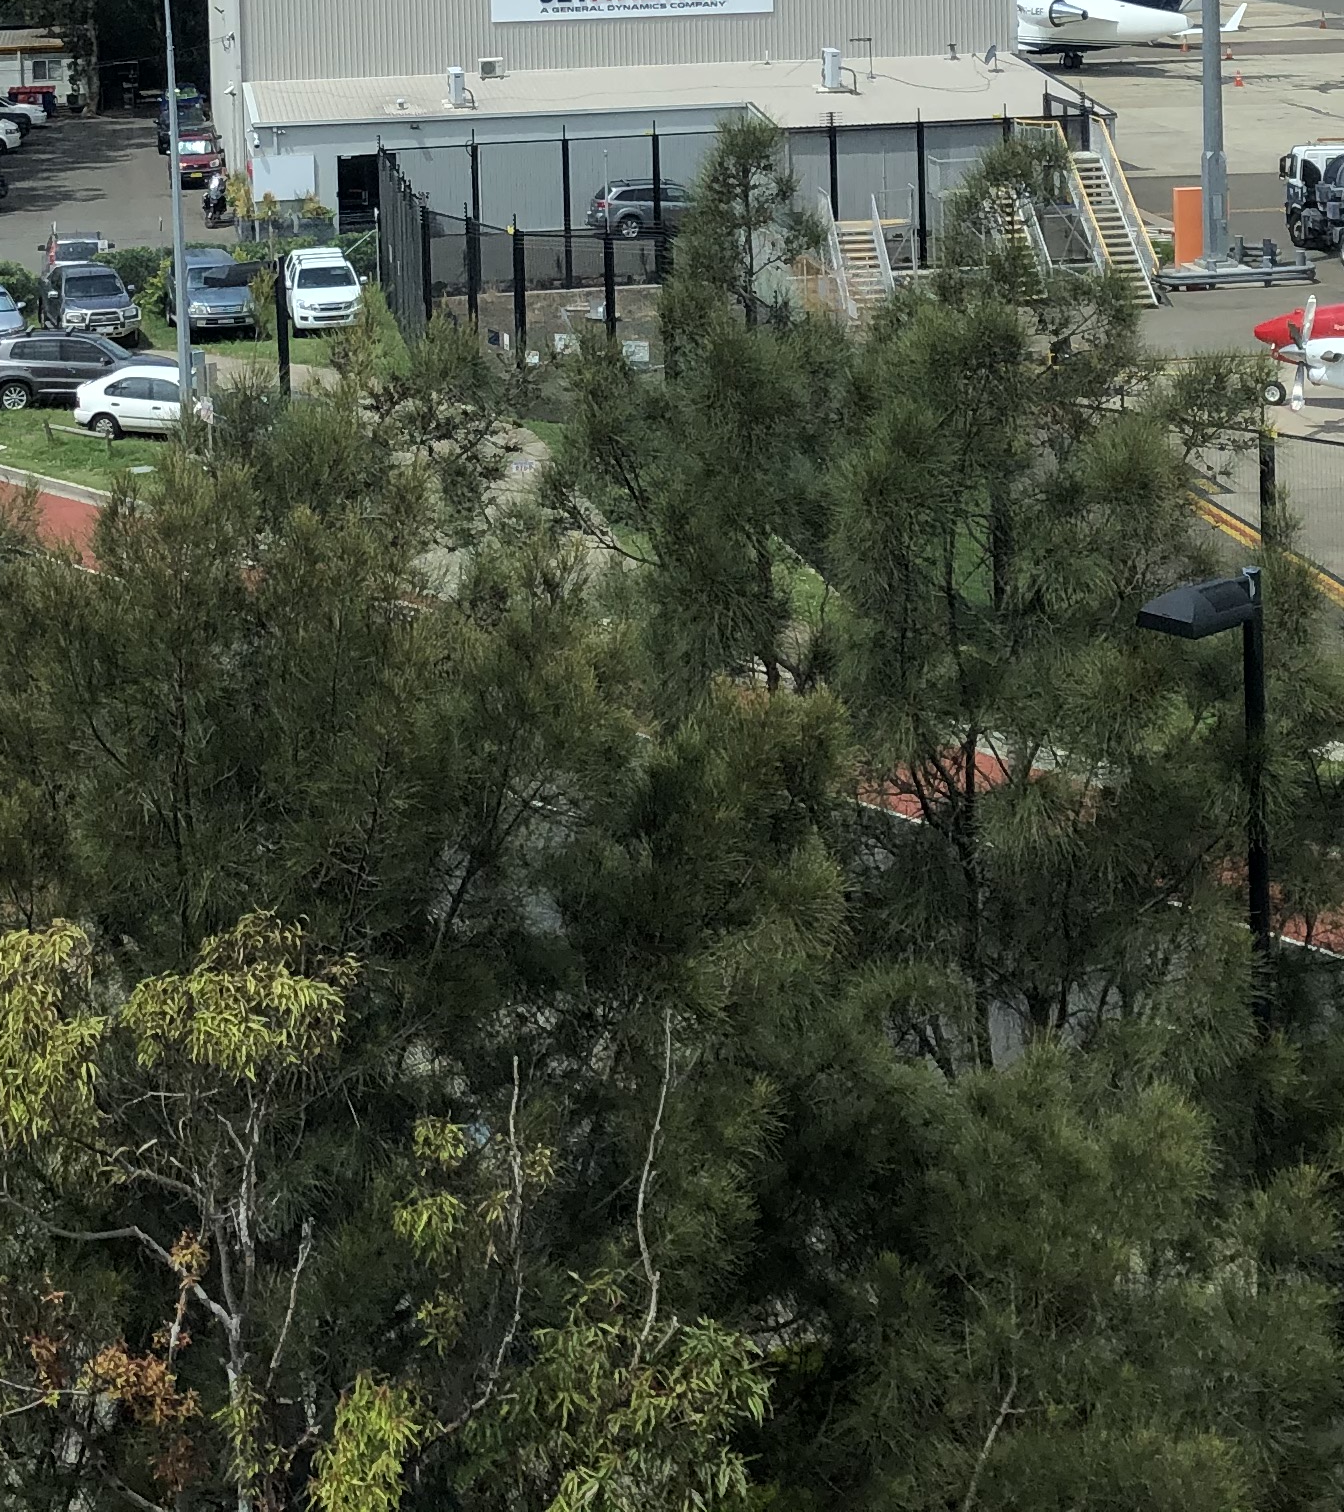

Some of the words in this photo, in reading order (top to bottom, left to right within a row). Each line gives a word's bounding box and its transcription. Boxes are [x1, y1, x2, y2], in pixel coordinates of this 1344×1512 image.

[552, 5, 604, 13] GENERAL
[607, 3, 667, 12] DYNAMICS
[670, 0, 726, 9] COMPANY
